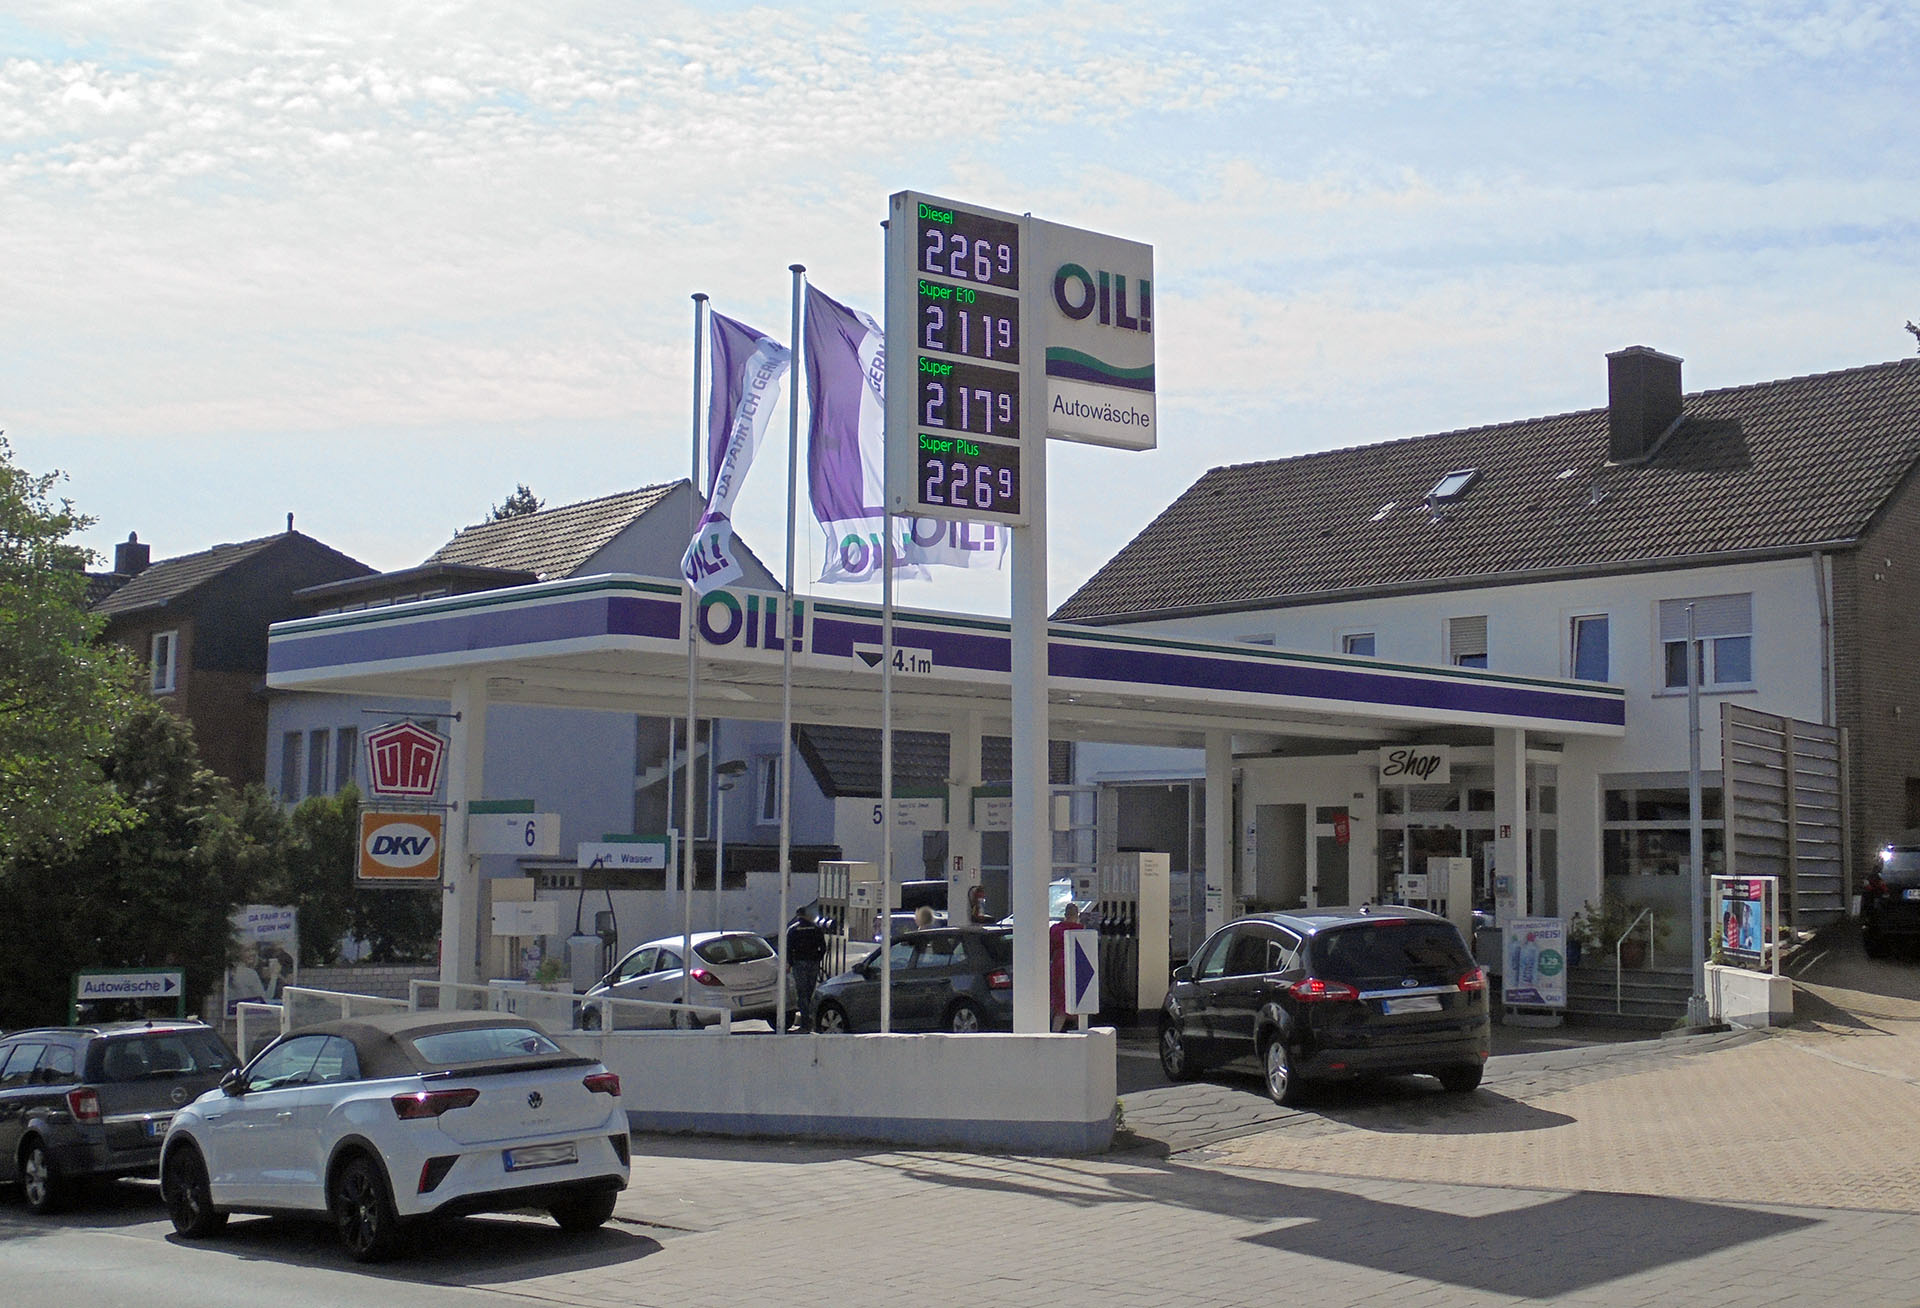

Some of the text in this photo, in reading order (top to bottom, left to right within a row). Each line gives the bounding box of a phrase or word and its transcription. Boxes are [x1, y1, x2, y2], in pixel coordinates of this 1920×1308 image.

[919, 203, 953, 225] Diesel
[919, 280, 975, 304] Super E10
[1053, 263, 1152, 335] OIL!
[919, 357, 953, 377] Super
[1052, 394, 1150, 428] Autowäsche
[717, 472, 732, 498] DA
[741, 392, 761, 421] ICH
[752, 356, 782, 390] GERN
[919, 434, 979, 456] Super Plus
[698, 590, 805, 653] OIL!
[376, 731, 437, 788] UTA
[1383, 750, 1441, 780] Shop
[872, 804, 883, 825] 5
[371, 835, 431, 856] DKV
[525, 820, 536, 847] 6
[596, 853, 653, 864] Luft Wasser
[83, 978, 161, 995] Autowäsche
